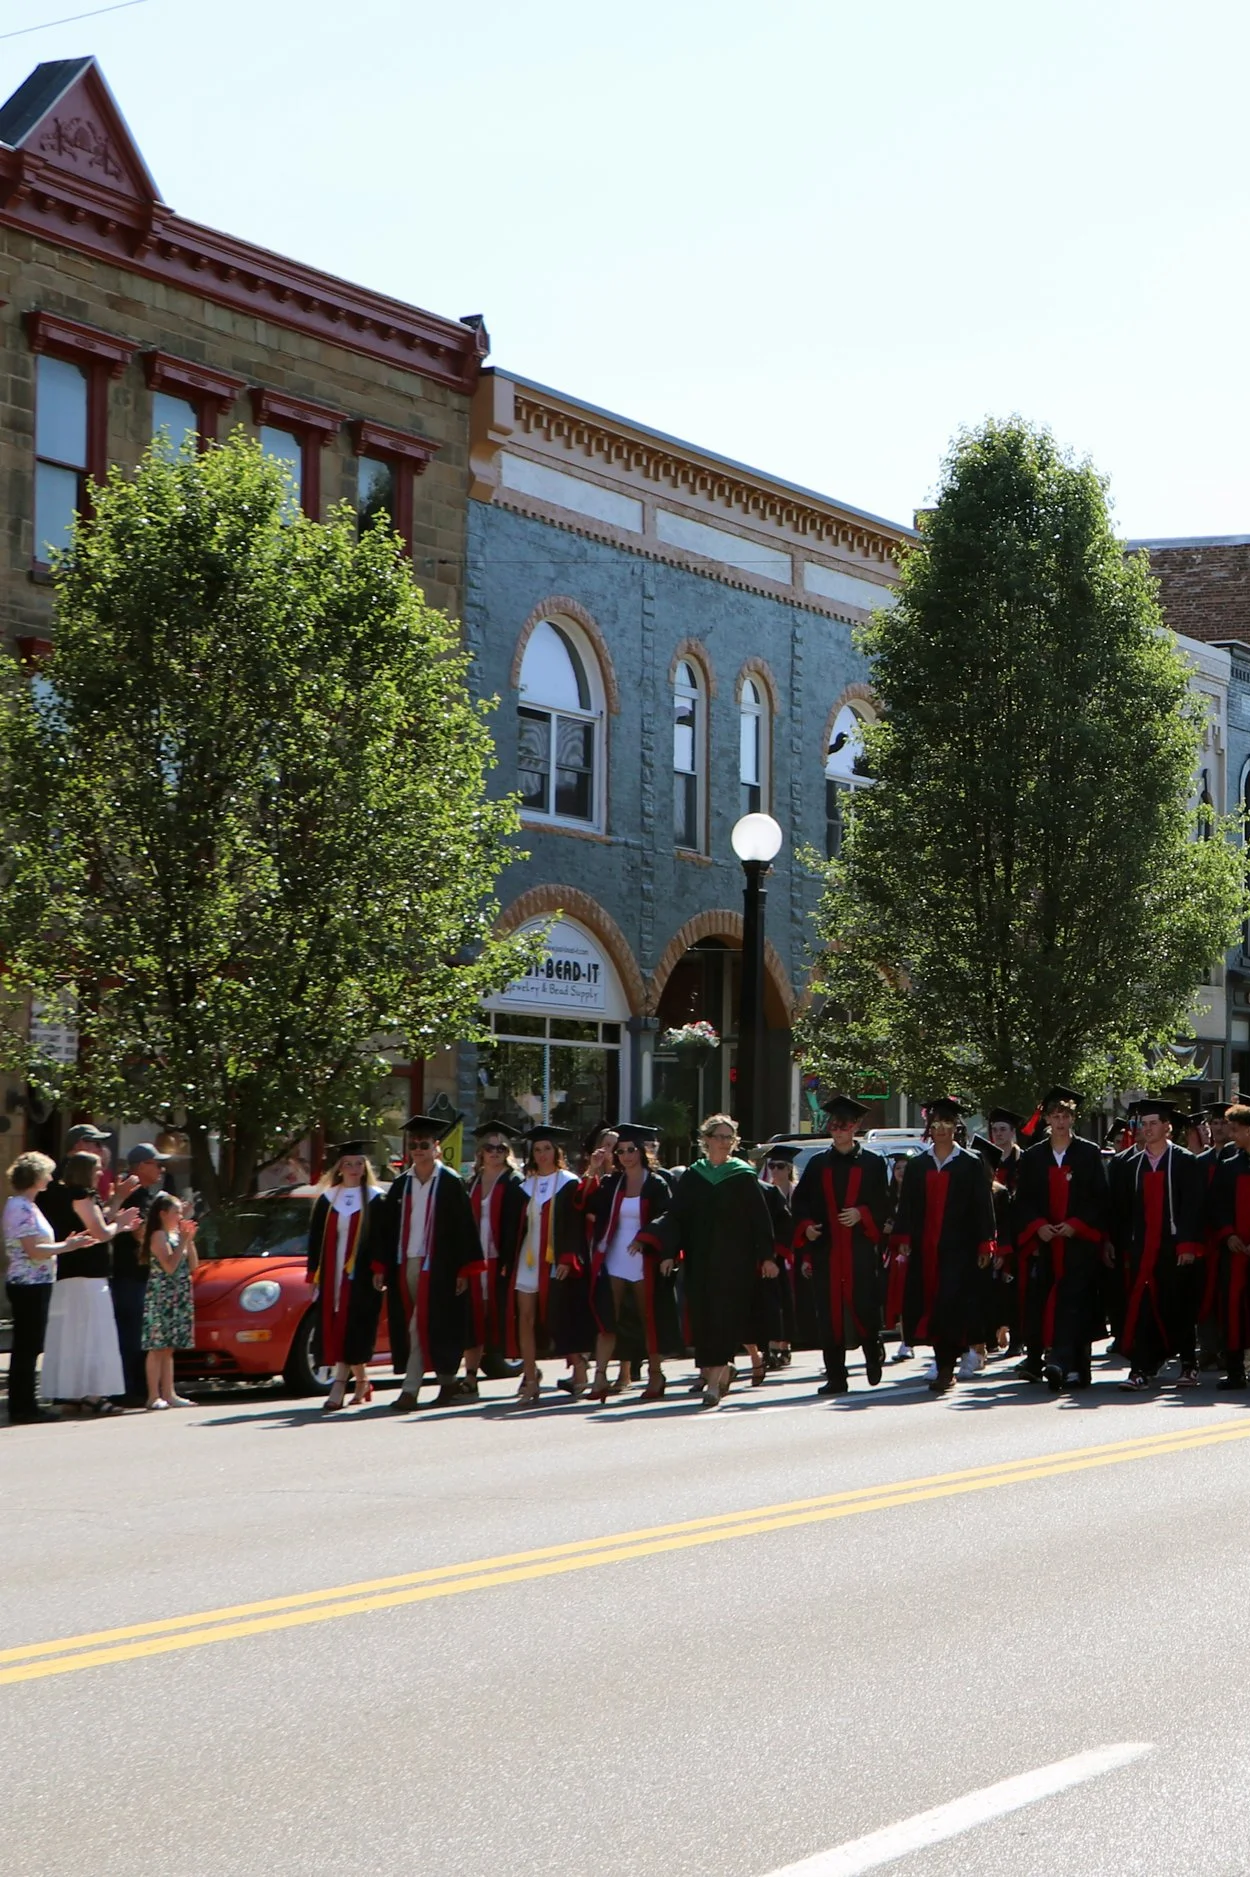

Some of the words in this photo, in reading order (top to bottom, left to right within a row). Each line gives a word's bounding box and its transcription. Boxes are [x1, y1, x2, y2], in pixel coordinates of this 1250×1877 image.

[541, 982, 548, 993] &
[549, 983, 569, 996] Bead
[570, 985, 599, 1003] Supply
